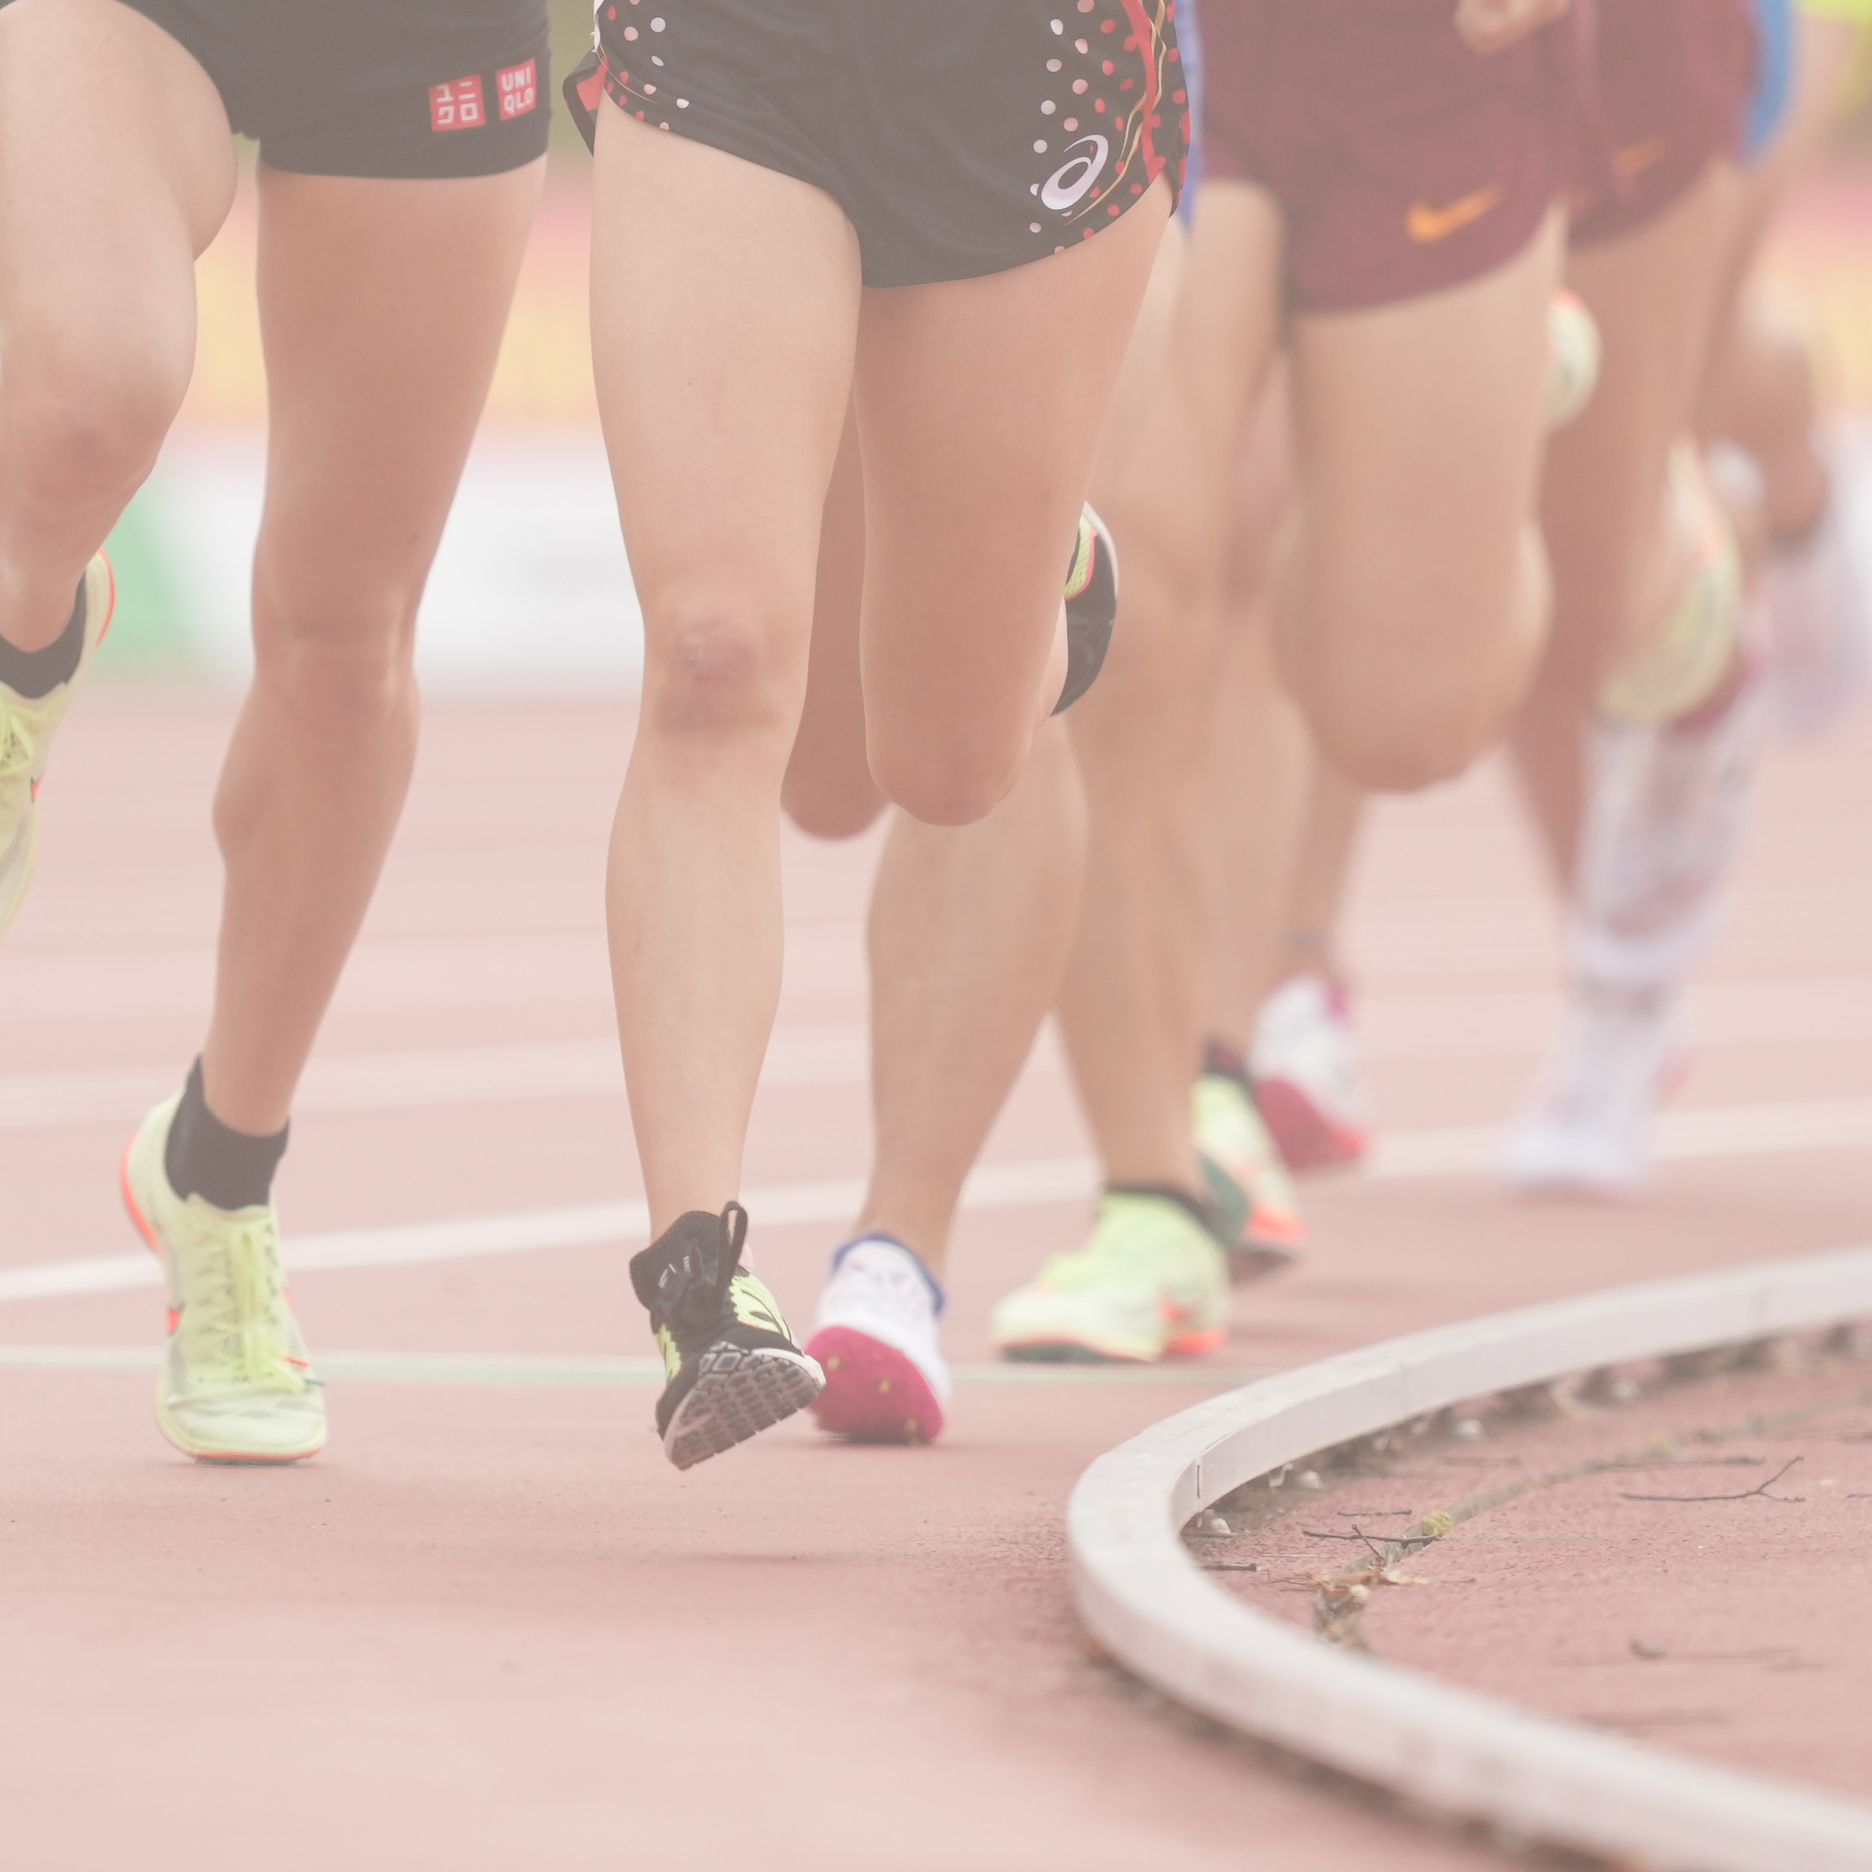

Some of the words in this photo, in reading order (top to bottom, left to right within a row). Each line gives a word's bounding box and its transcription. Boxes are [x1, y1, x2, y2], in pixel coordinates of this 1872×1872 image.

[501, 66, 532, 92] UNI
[436, 80, 477, 103] ユニ
[504, 86, 535, 114] QLO
[437, 102, 479, 125] クロ
